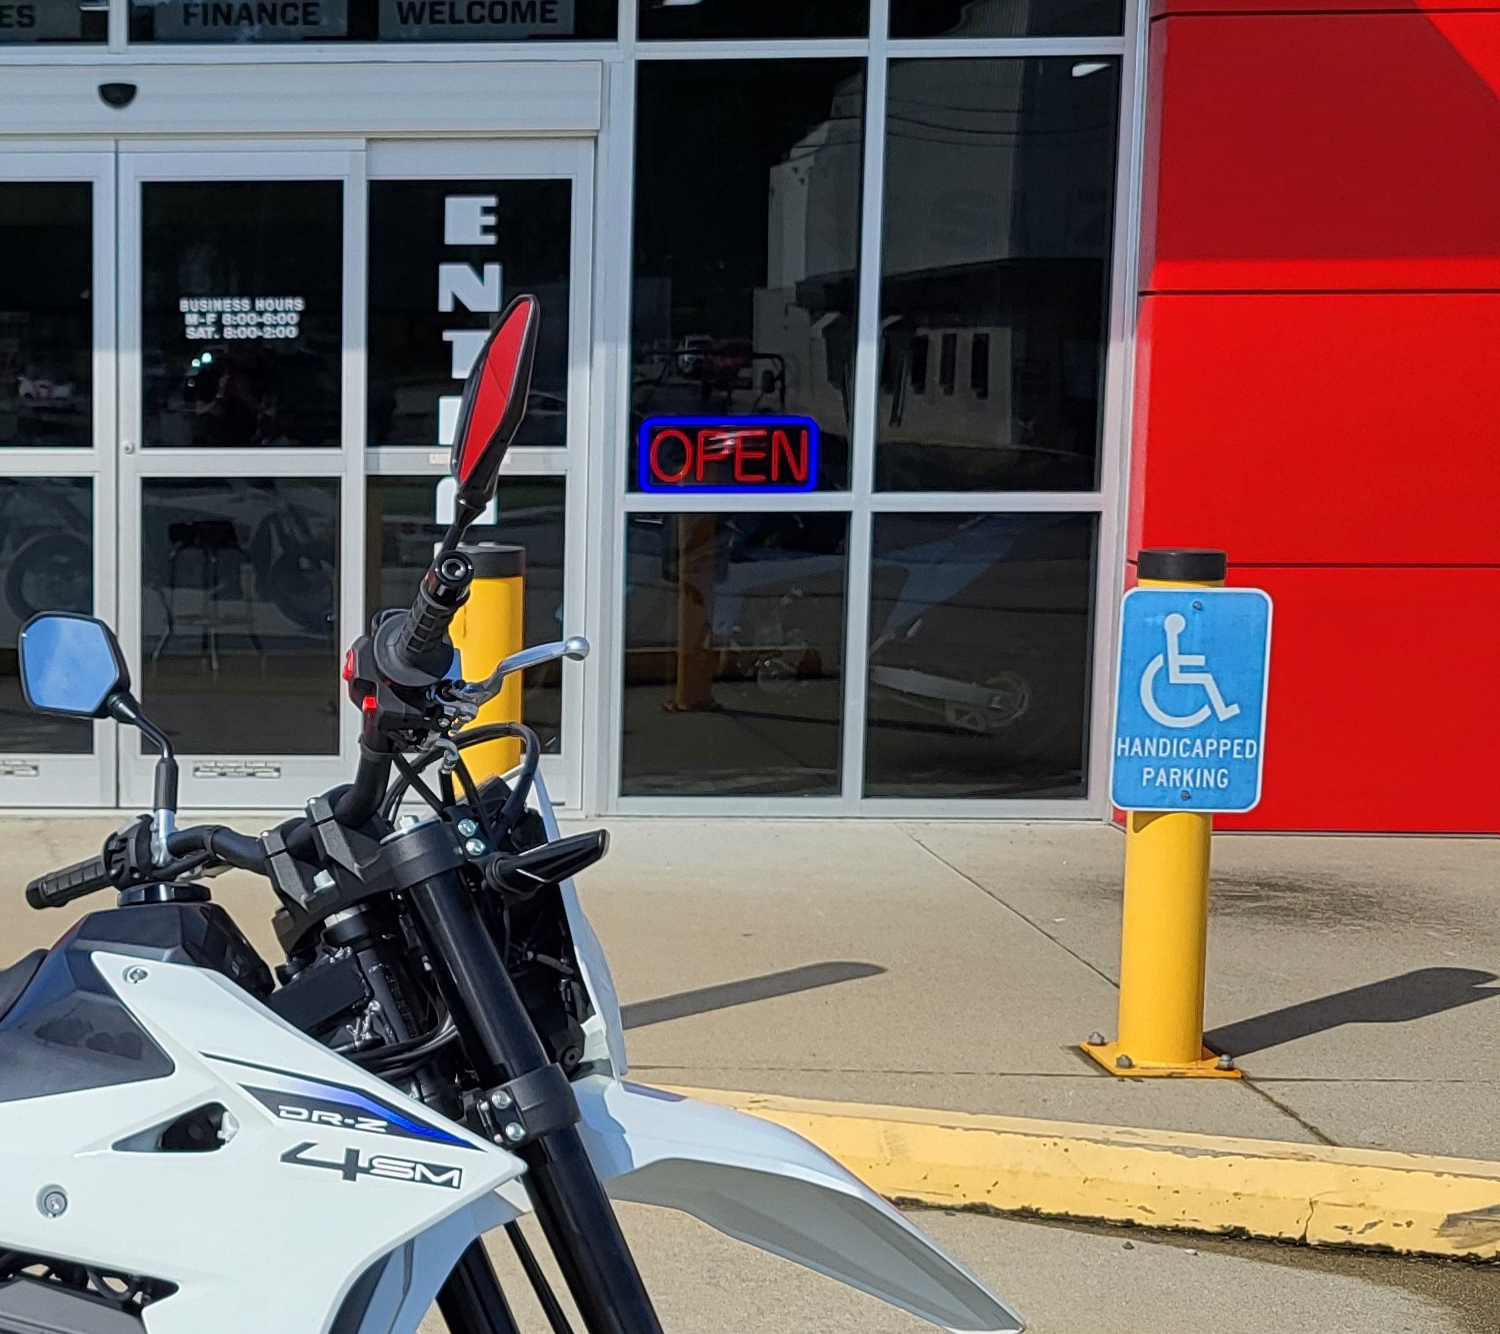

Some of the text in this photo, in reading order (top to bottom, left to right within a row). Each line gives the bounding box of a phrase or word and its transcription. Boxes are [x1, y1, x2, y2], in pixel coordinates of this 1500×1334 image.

[182, 2, 321, 26] FINANCE
[396, 0, 559, 25] WELCOME
[180, 296, 305, 312] BUSINESS HOURS
[184, 312, 218, 325] M-F
[185, 325, 220, 339] SAT.
[650, 428, 808, 483] OPEN
[1116, 737, 1257, 759] HANDICAPPED
[1141, 768, 1230, 788] PARKING
[277, 1104, 388, 1134] DR-Z
[280, 1141, 463, 1189] 4SM
